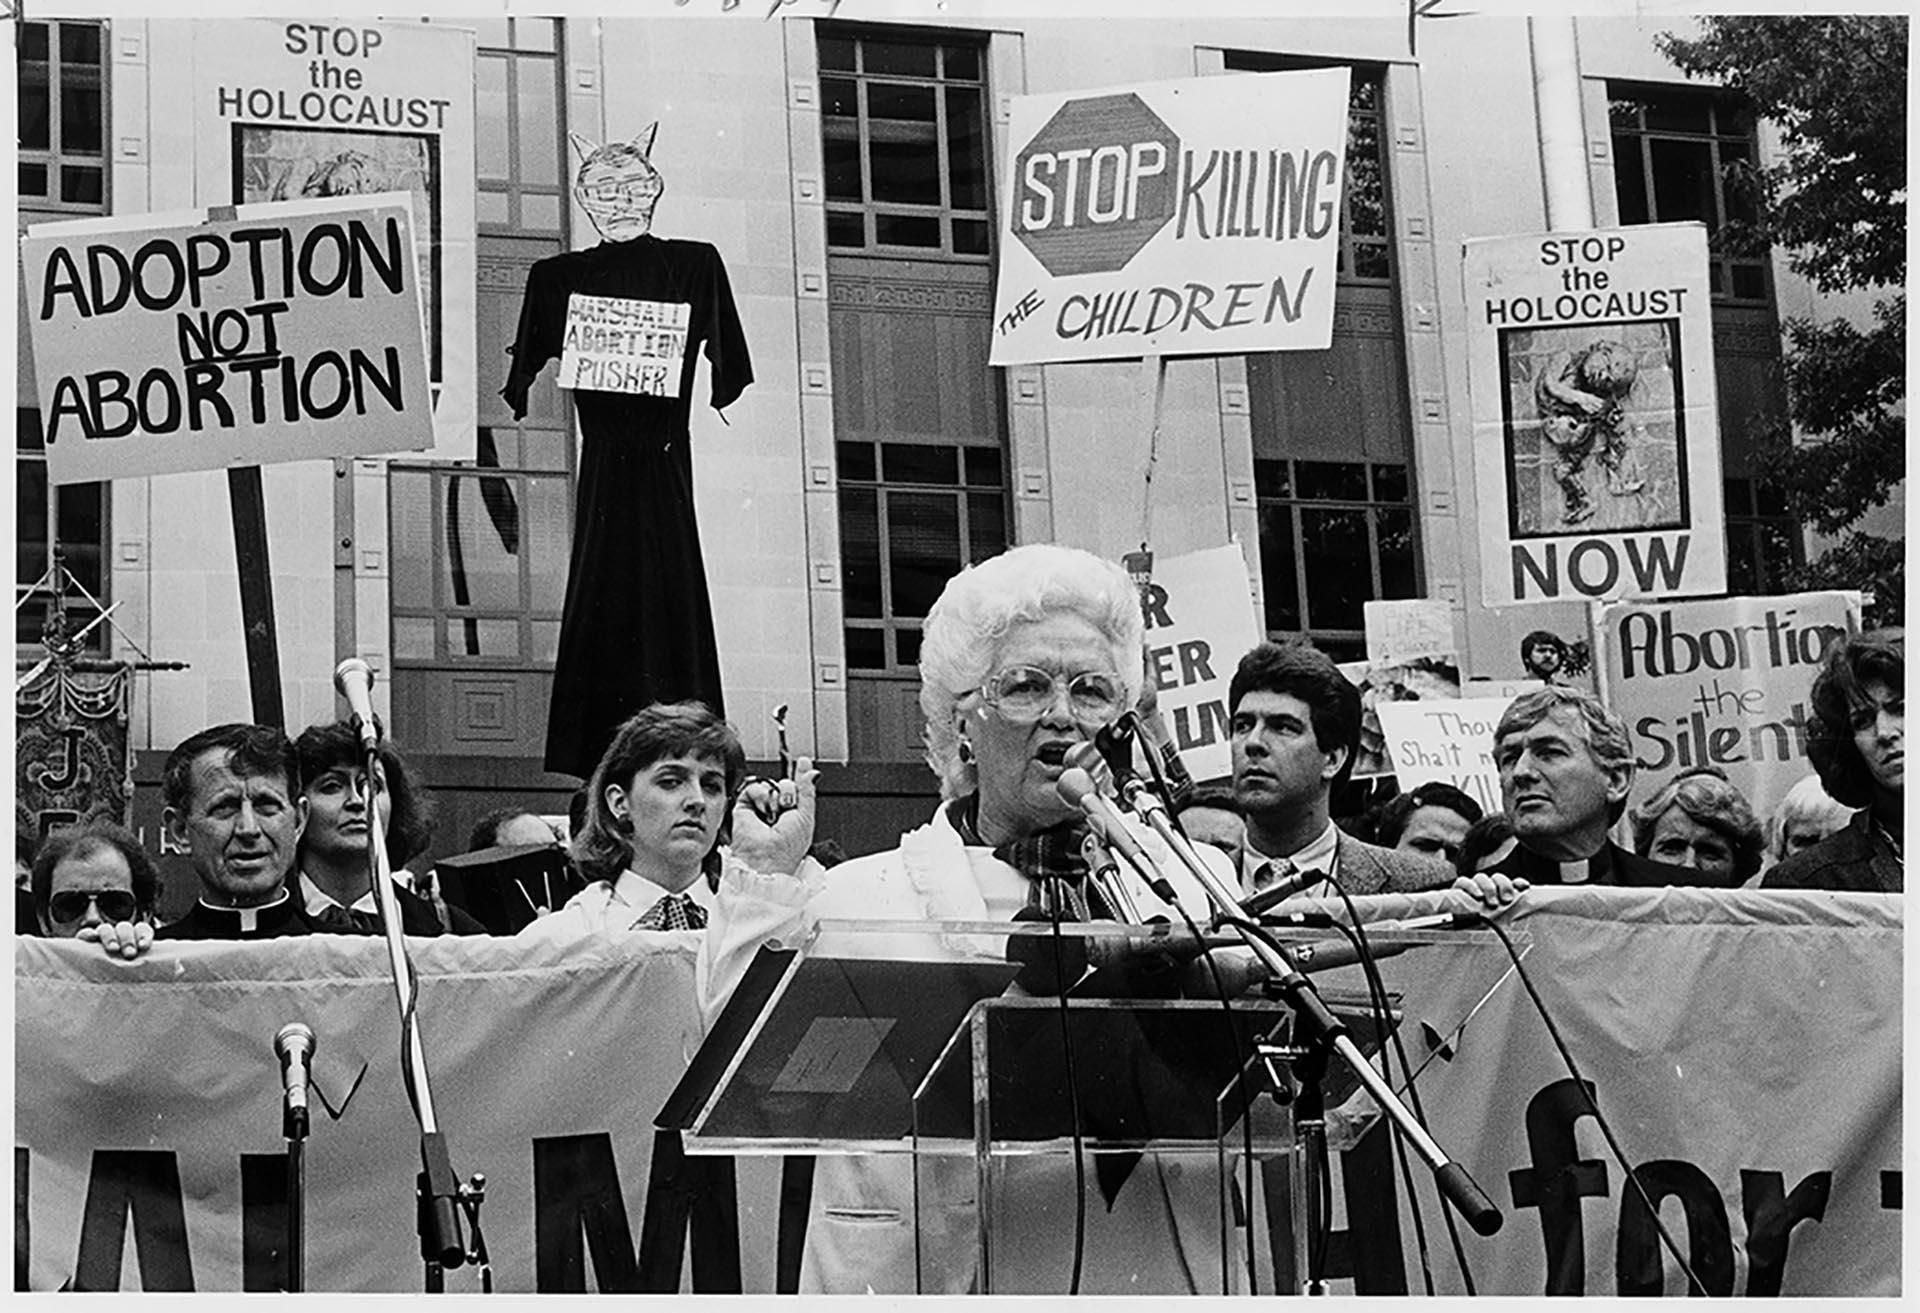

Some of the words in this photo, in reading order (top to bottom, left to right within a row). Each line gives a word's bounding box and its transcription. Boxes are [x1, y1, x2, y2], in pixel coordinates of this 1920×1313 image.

[285, 24, 382, 58] STOP
[309, 60, 363, 90] the
[219, 86, 450, 128] HOLOCAUST
[1022, 141, 1166, 230] STOP
[1176, 149, 1338, 241] KILLING
[40, 217, 403, 320] ADOPTION
[1540, 237, 1625, 265] STOP
[1561, 266, 1609, 292] the
[999, 289, 1045, 336] THE
[1056, 267, 1314, 341] CHILDREN
[1486, 288, 1688, 324] HOLOCAUST
[178, 301, 289, 364] NOT
[565, 324, 685, 359] ABORTION
[46, 347, 404, 443] ABORTION
[576, 357, 668, 397] PUSHER
[1511, 535, 1691, 600] NOW
[1143, 639, 1217, 691] ER
[1694, 679, 1765, 718] the
[1401, 739, 1461, 767] Shalt
[1635, 702, 1808, 771] Silent
